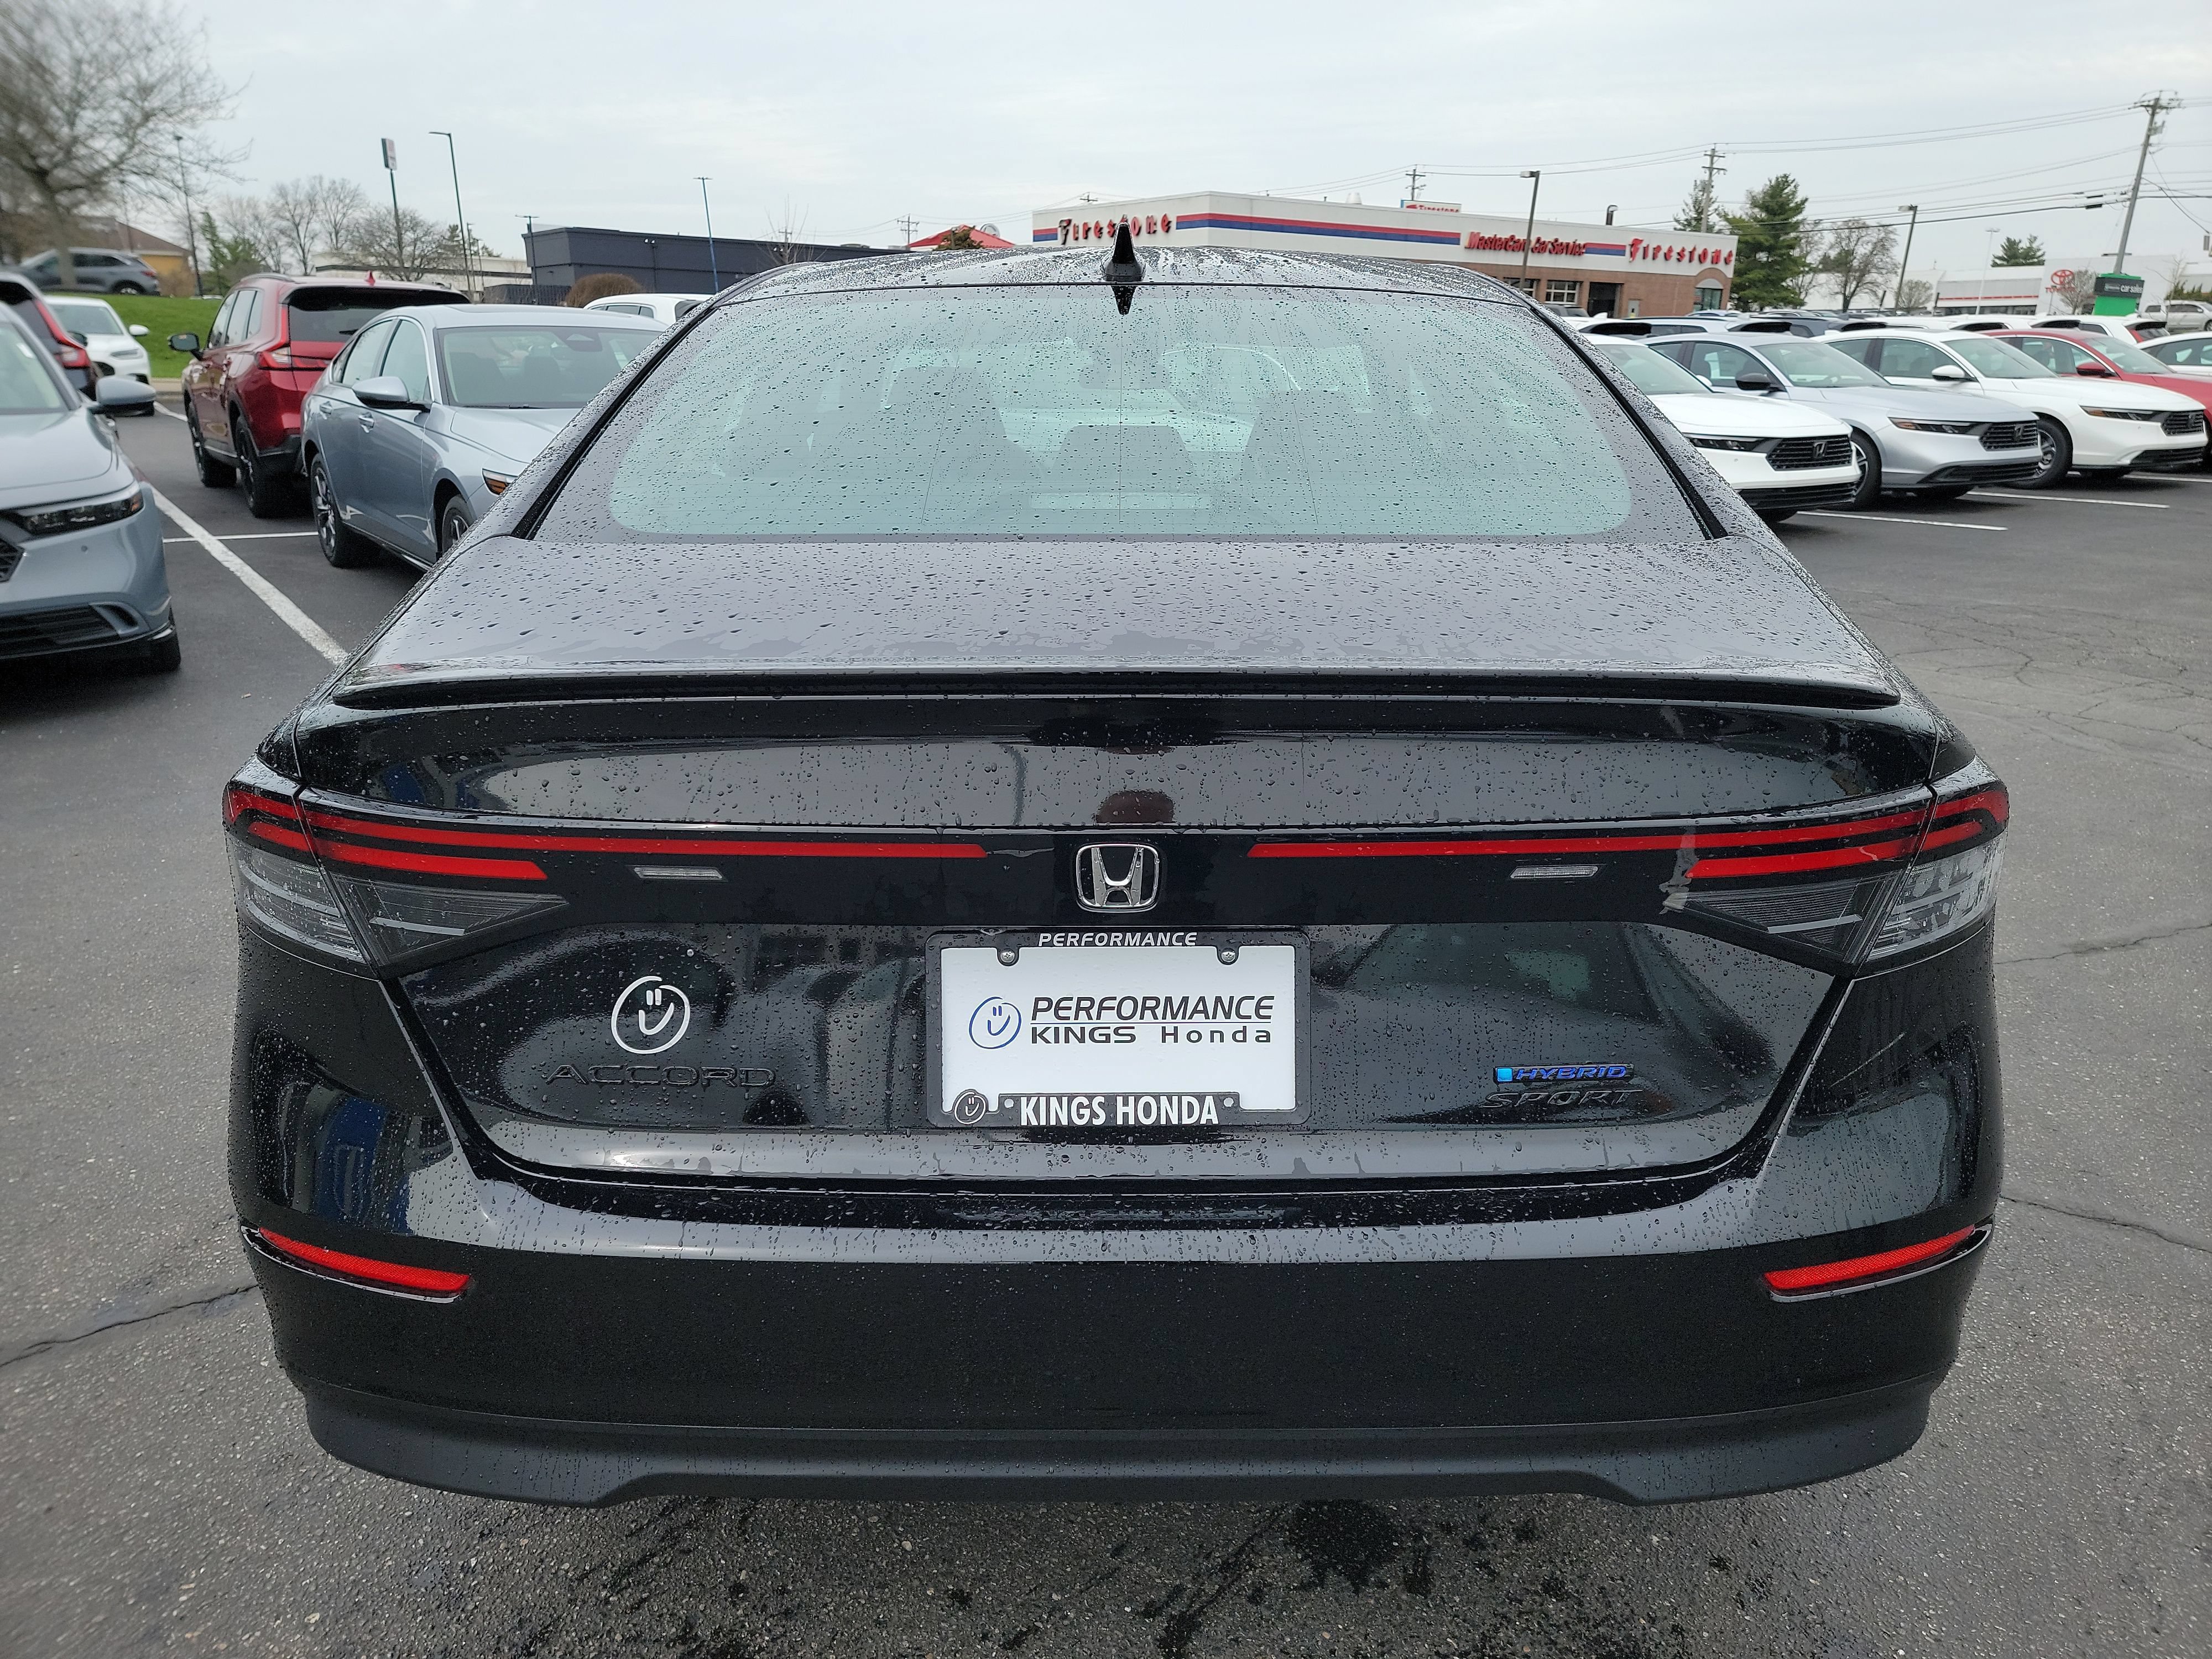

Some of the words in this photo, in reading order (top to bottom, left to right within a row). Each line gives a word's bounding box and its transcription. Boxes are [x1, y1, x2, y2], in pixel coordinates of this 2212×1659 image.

[1465, 231, 1531, 252] MasterCar
[1549, 238, 1585, 255] Service
[1629, 238, 1734, 265] Firestone
[1038, 932, 1198, 947] PERFORMANCE
[1031, 995, 1275, 1021] PERFORMANCE
[1031, 1026, 1137, 1044] KINGS
[1161, 1025, 1271, 1044] Honda
[545, 1064, 776, 1088] ACCORD
[1516, 1066, 1628, 1080] HYBRID
[1020, 1095, 1107, 1126] KINGS
[1116, 1095, 1219, 1125] HONDA
[1480, 1089, 1644, 1108] SPORT
